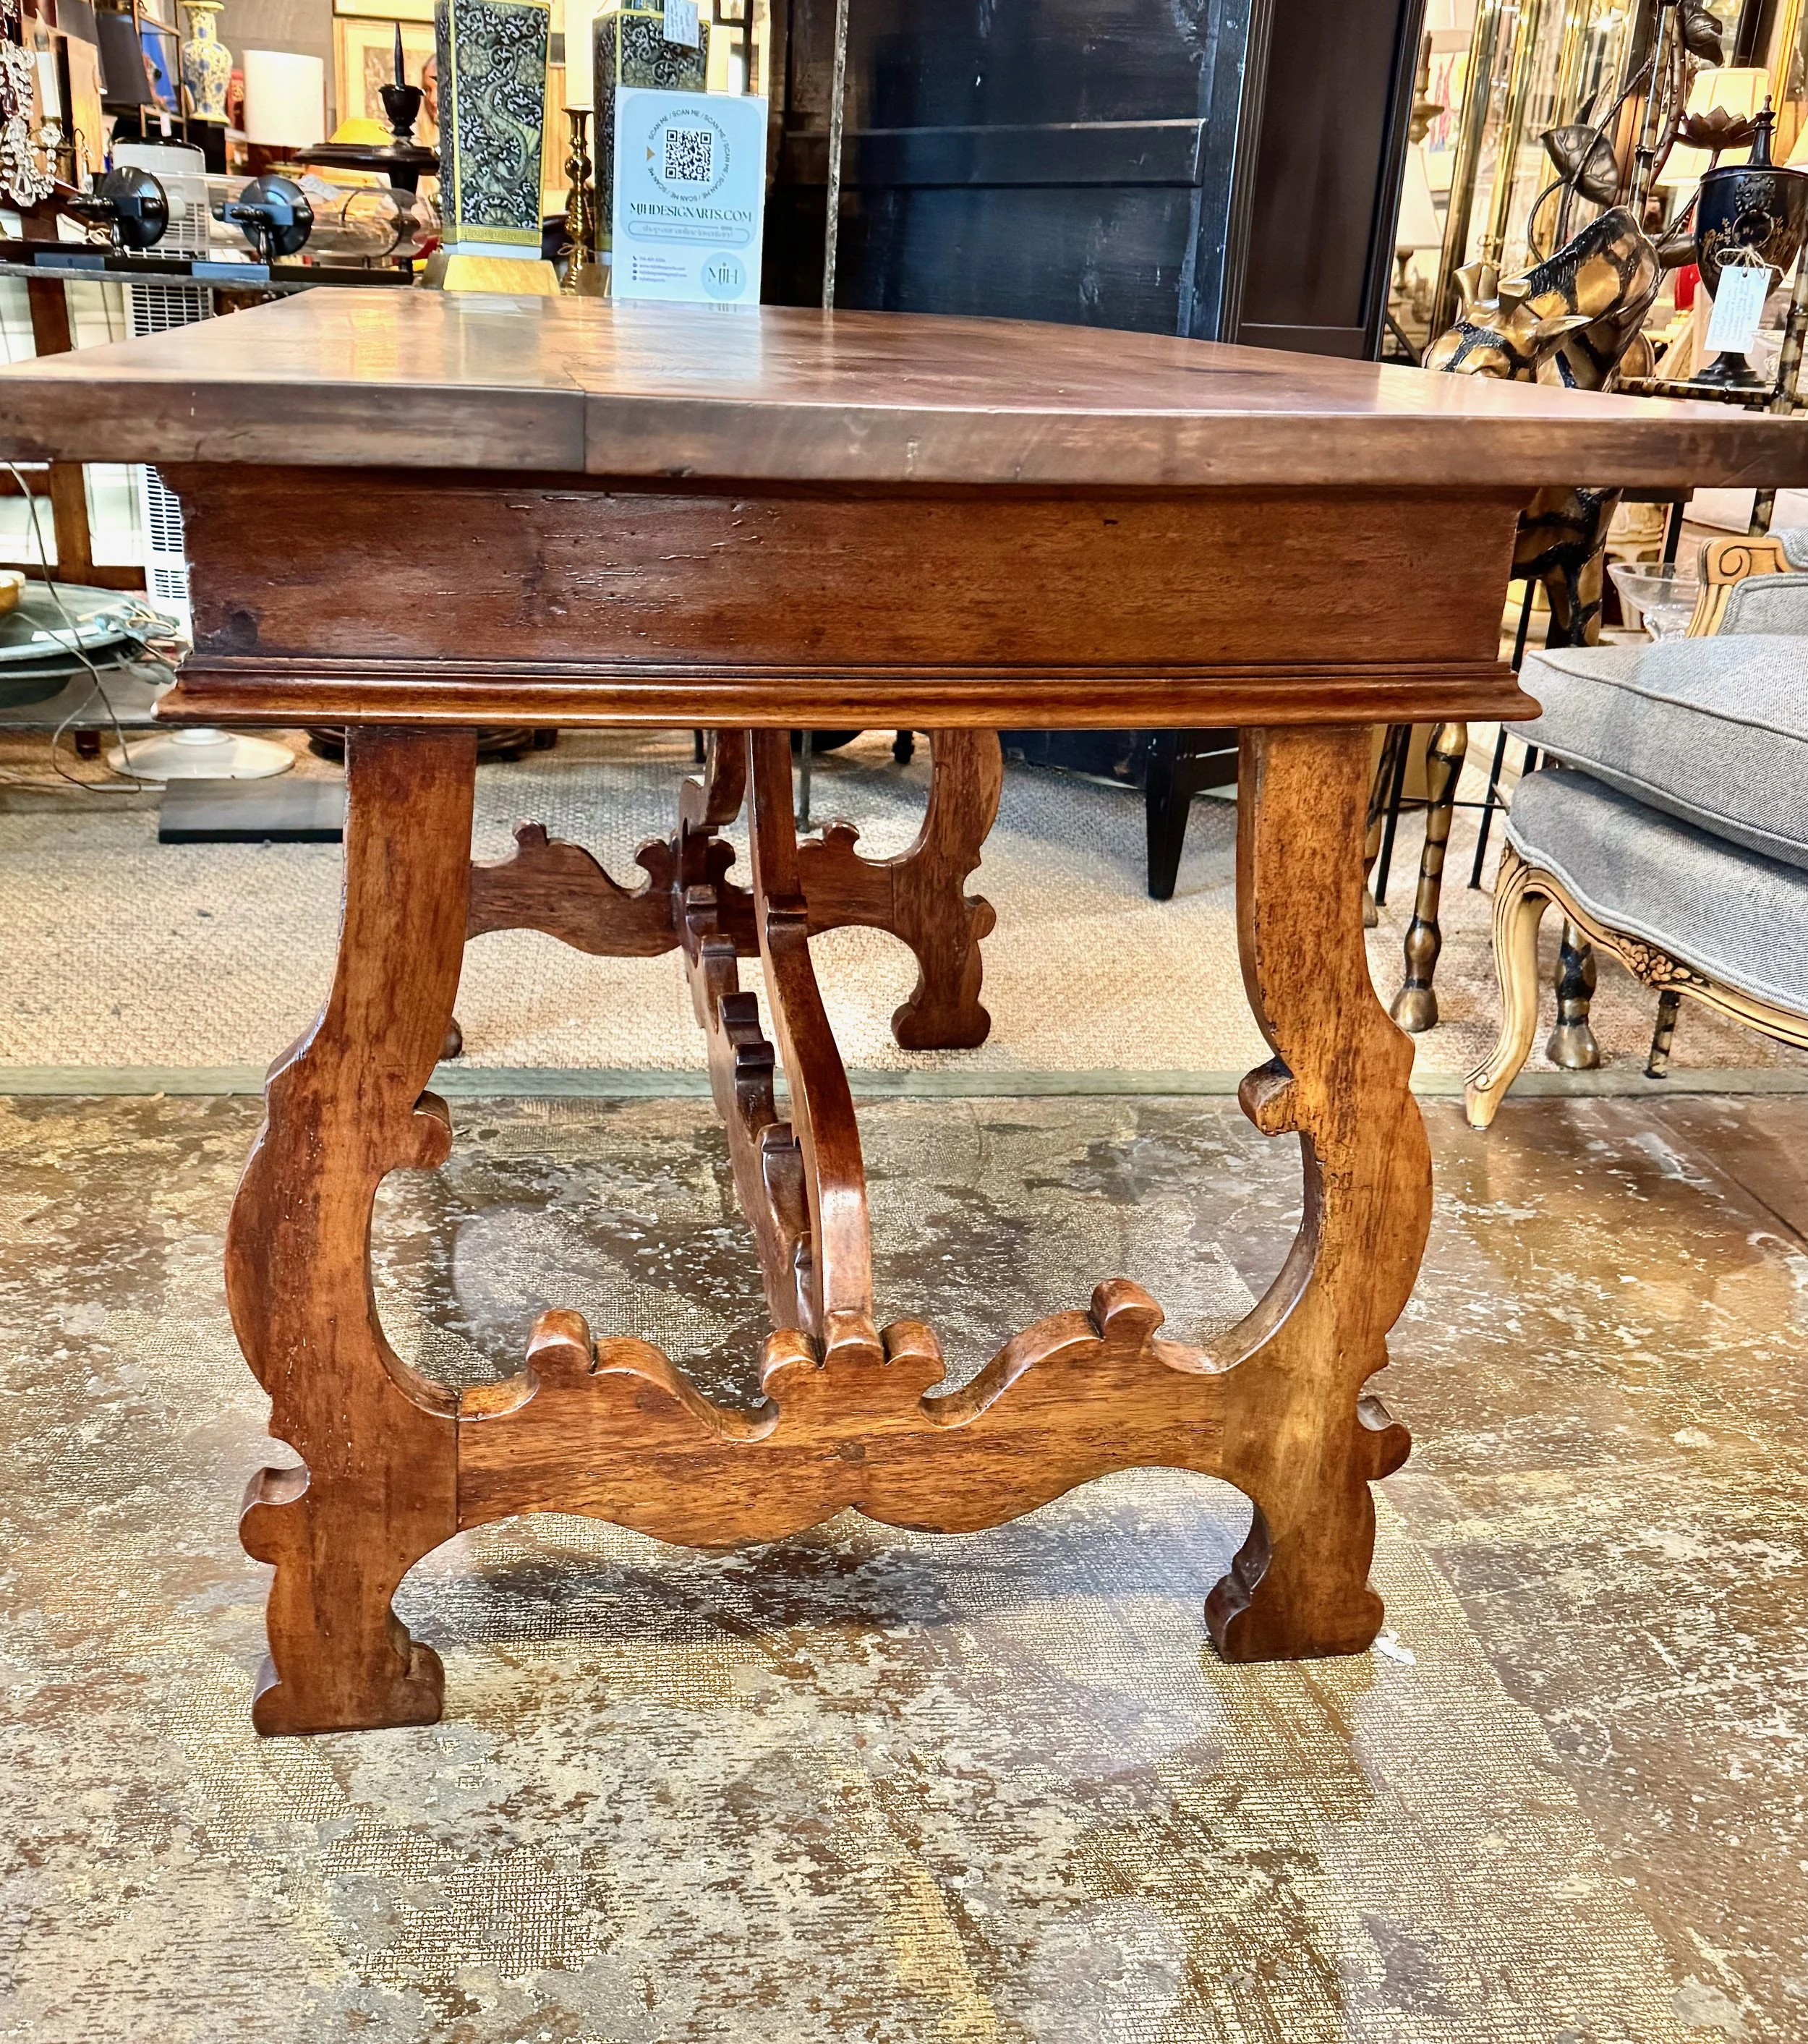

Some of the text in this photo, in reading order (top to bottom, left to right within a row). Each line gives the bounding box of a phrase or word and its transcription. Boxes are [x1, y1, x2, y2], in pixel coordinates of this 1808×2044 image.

[660, 116, 668, 124] ME
[704, 114, 719, 129] SCAN
[649, 123, 661, 140] SCAN
[718, 129, 725, 138] ME
[648, 167, 654, 176] ME
[724, 163, 730, 174] ME
[653, 176, 667, 192] SCAN
[710, 176, 725, 193] SCAN
[670, 191, 679, 200] ME
[702, 190, 711, 199] ME
